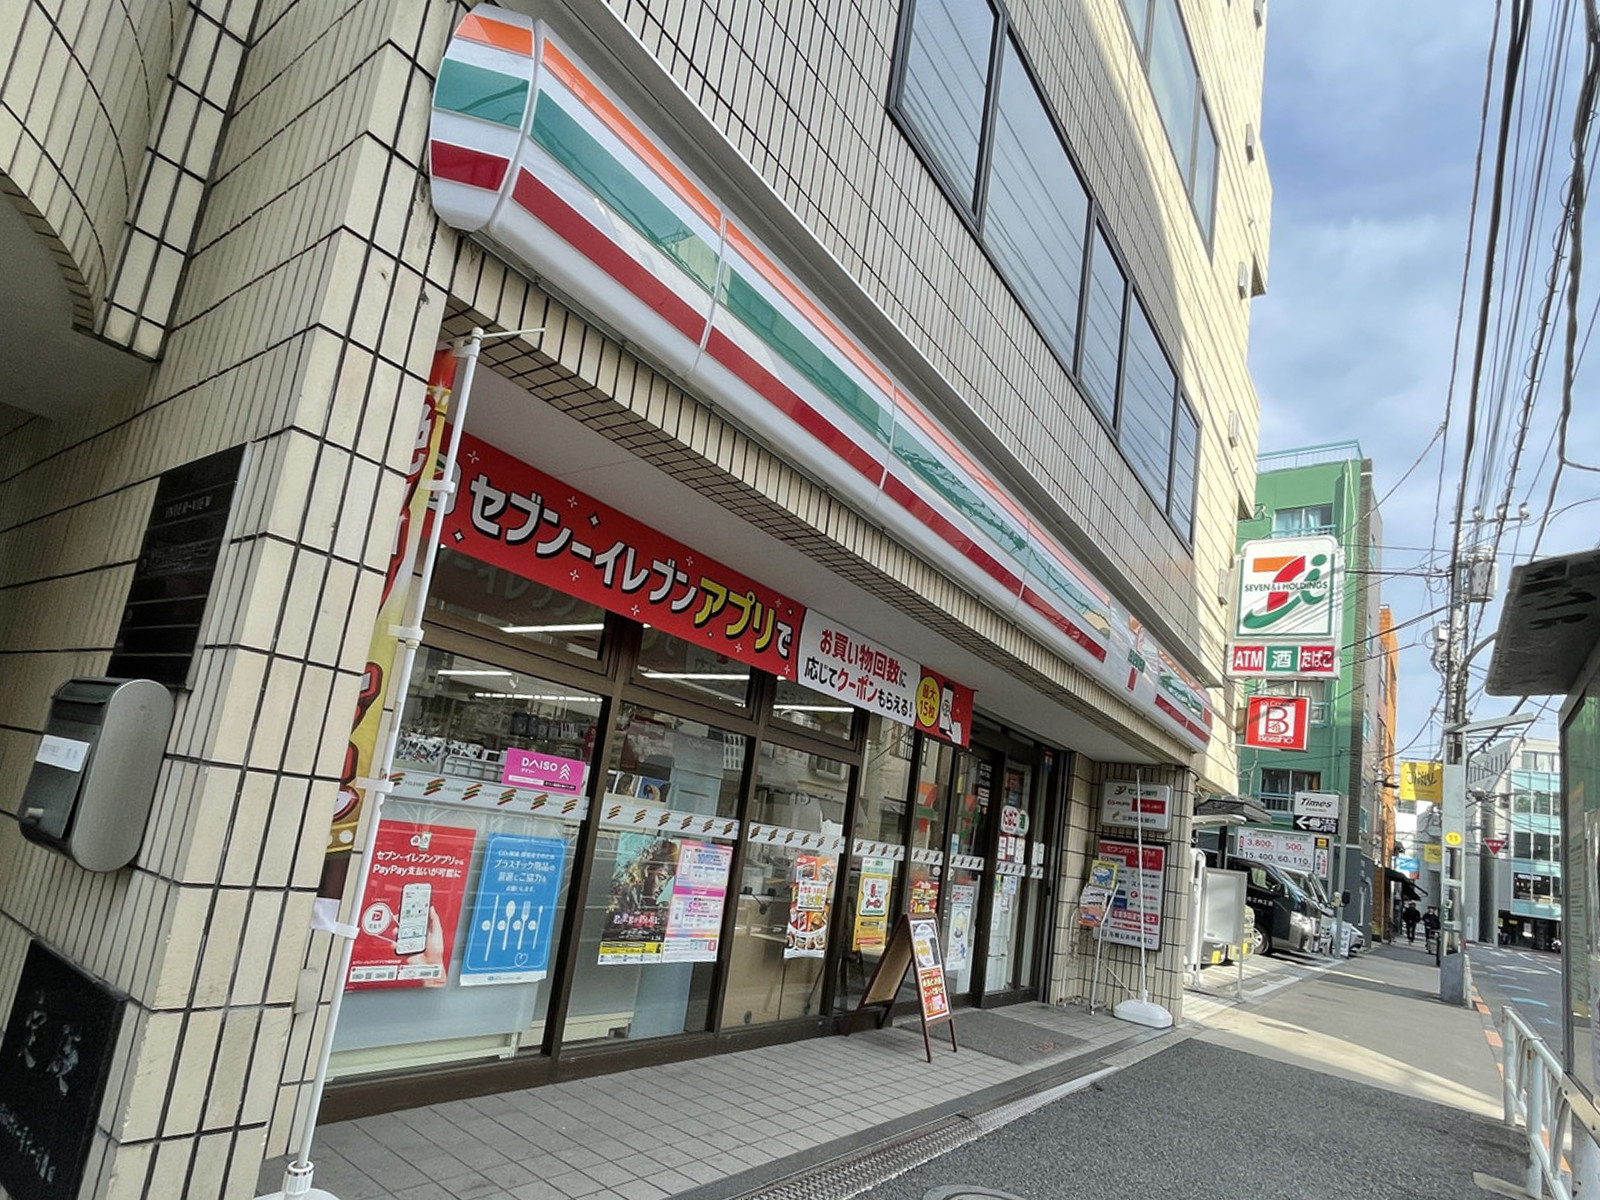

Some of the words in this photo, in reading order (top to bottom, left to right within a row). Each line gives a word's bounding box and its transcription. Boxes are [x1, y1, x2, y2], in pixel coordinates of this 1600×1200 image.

[1244, 583, 1272, 592] SEVEN
[1282, 580, 1328, 591] HOLDINGS
[819, 628, 907, 689] お買い物回数に
[1234, 649, 1263, 668] ATM
[1271, 650, 1293, 669] 酒
[1301, 650, 1332, 669] たばこ
[922, 683, 937, 702] 最大
[919, 699, 936, 719] 15枚
[521, 757, 558, 772] DAISO
[1300, 797, 1333, 809] Times
